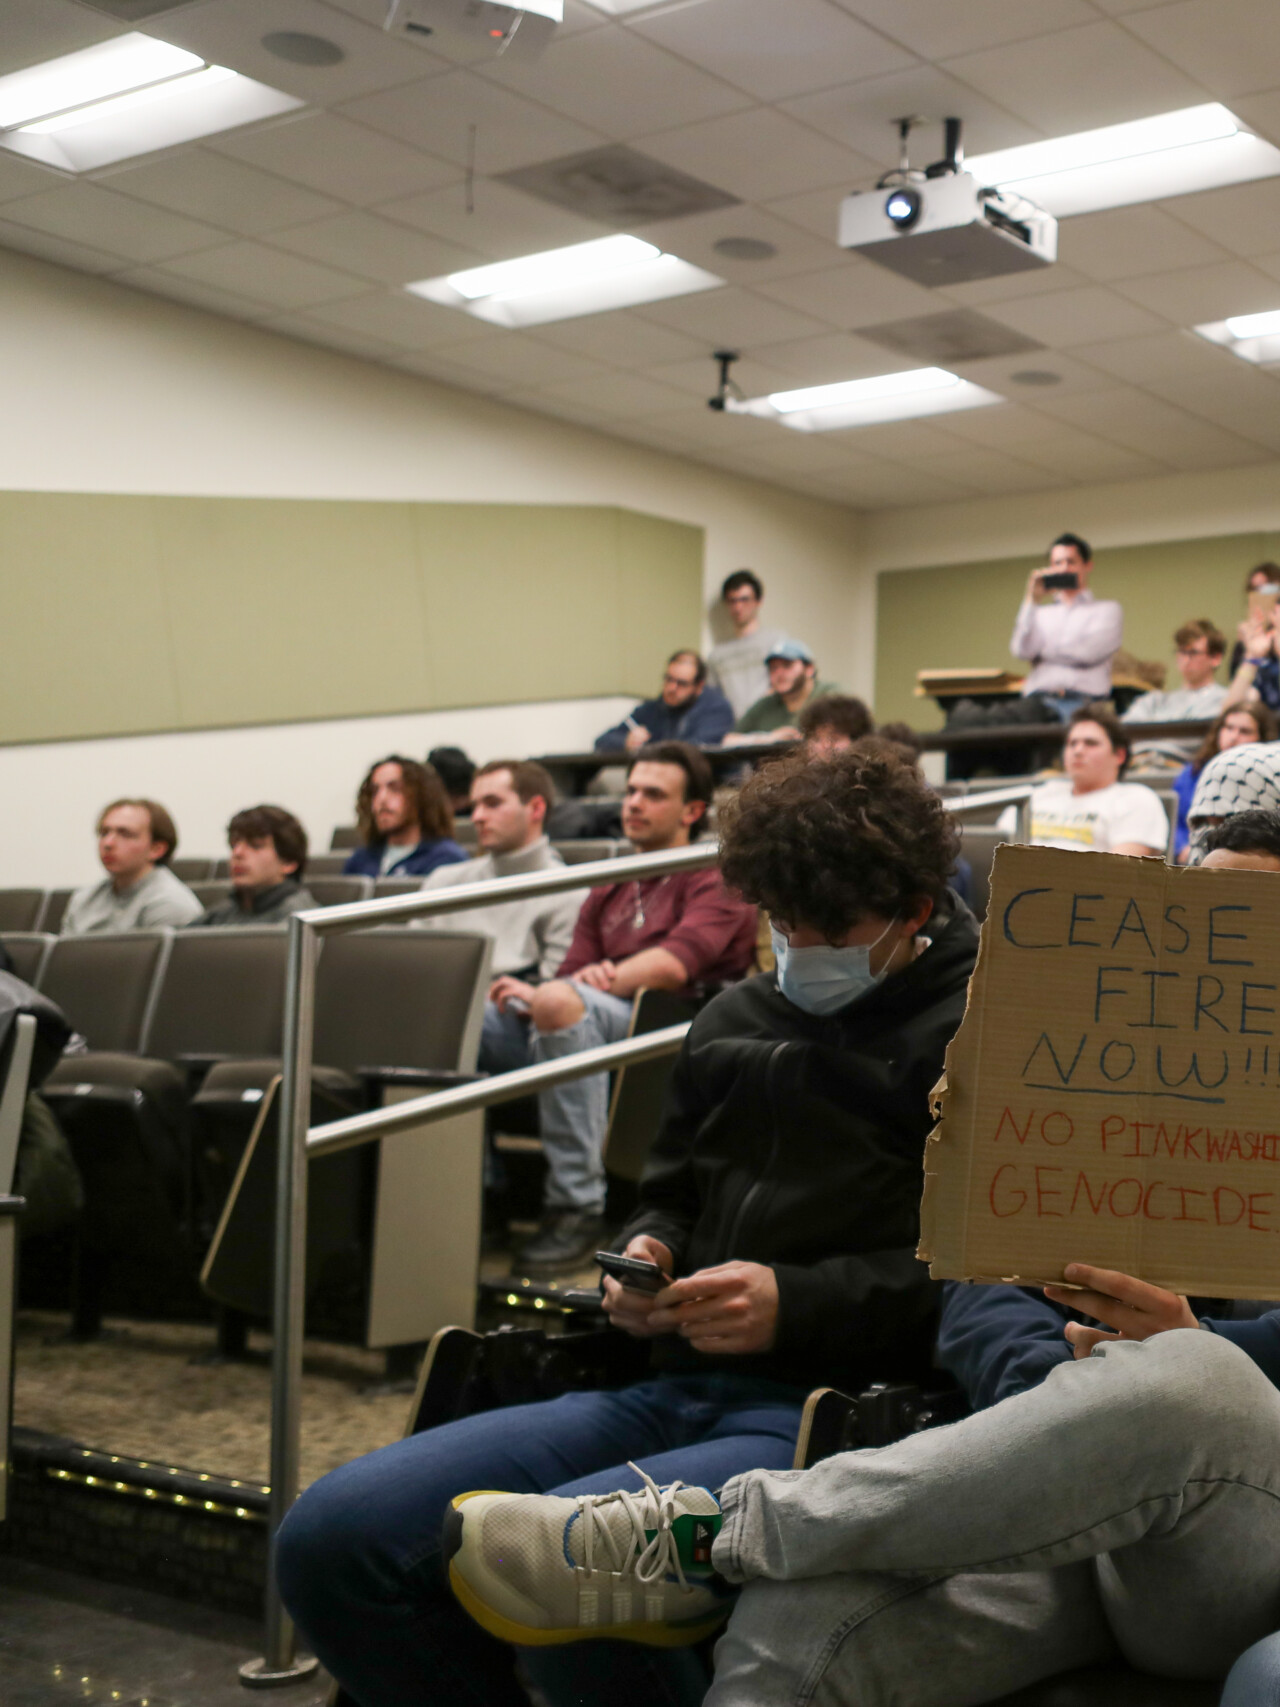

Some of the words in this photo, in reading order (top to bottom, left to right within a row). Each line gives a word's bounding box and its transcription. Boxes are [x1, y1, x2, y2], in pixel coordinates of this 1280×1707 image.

[1003, 887, 1255, 968] CEASE
[1093, 966, 1278, 1036] FIRE
[994, 1106, 1074, 1146] NO
